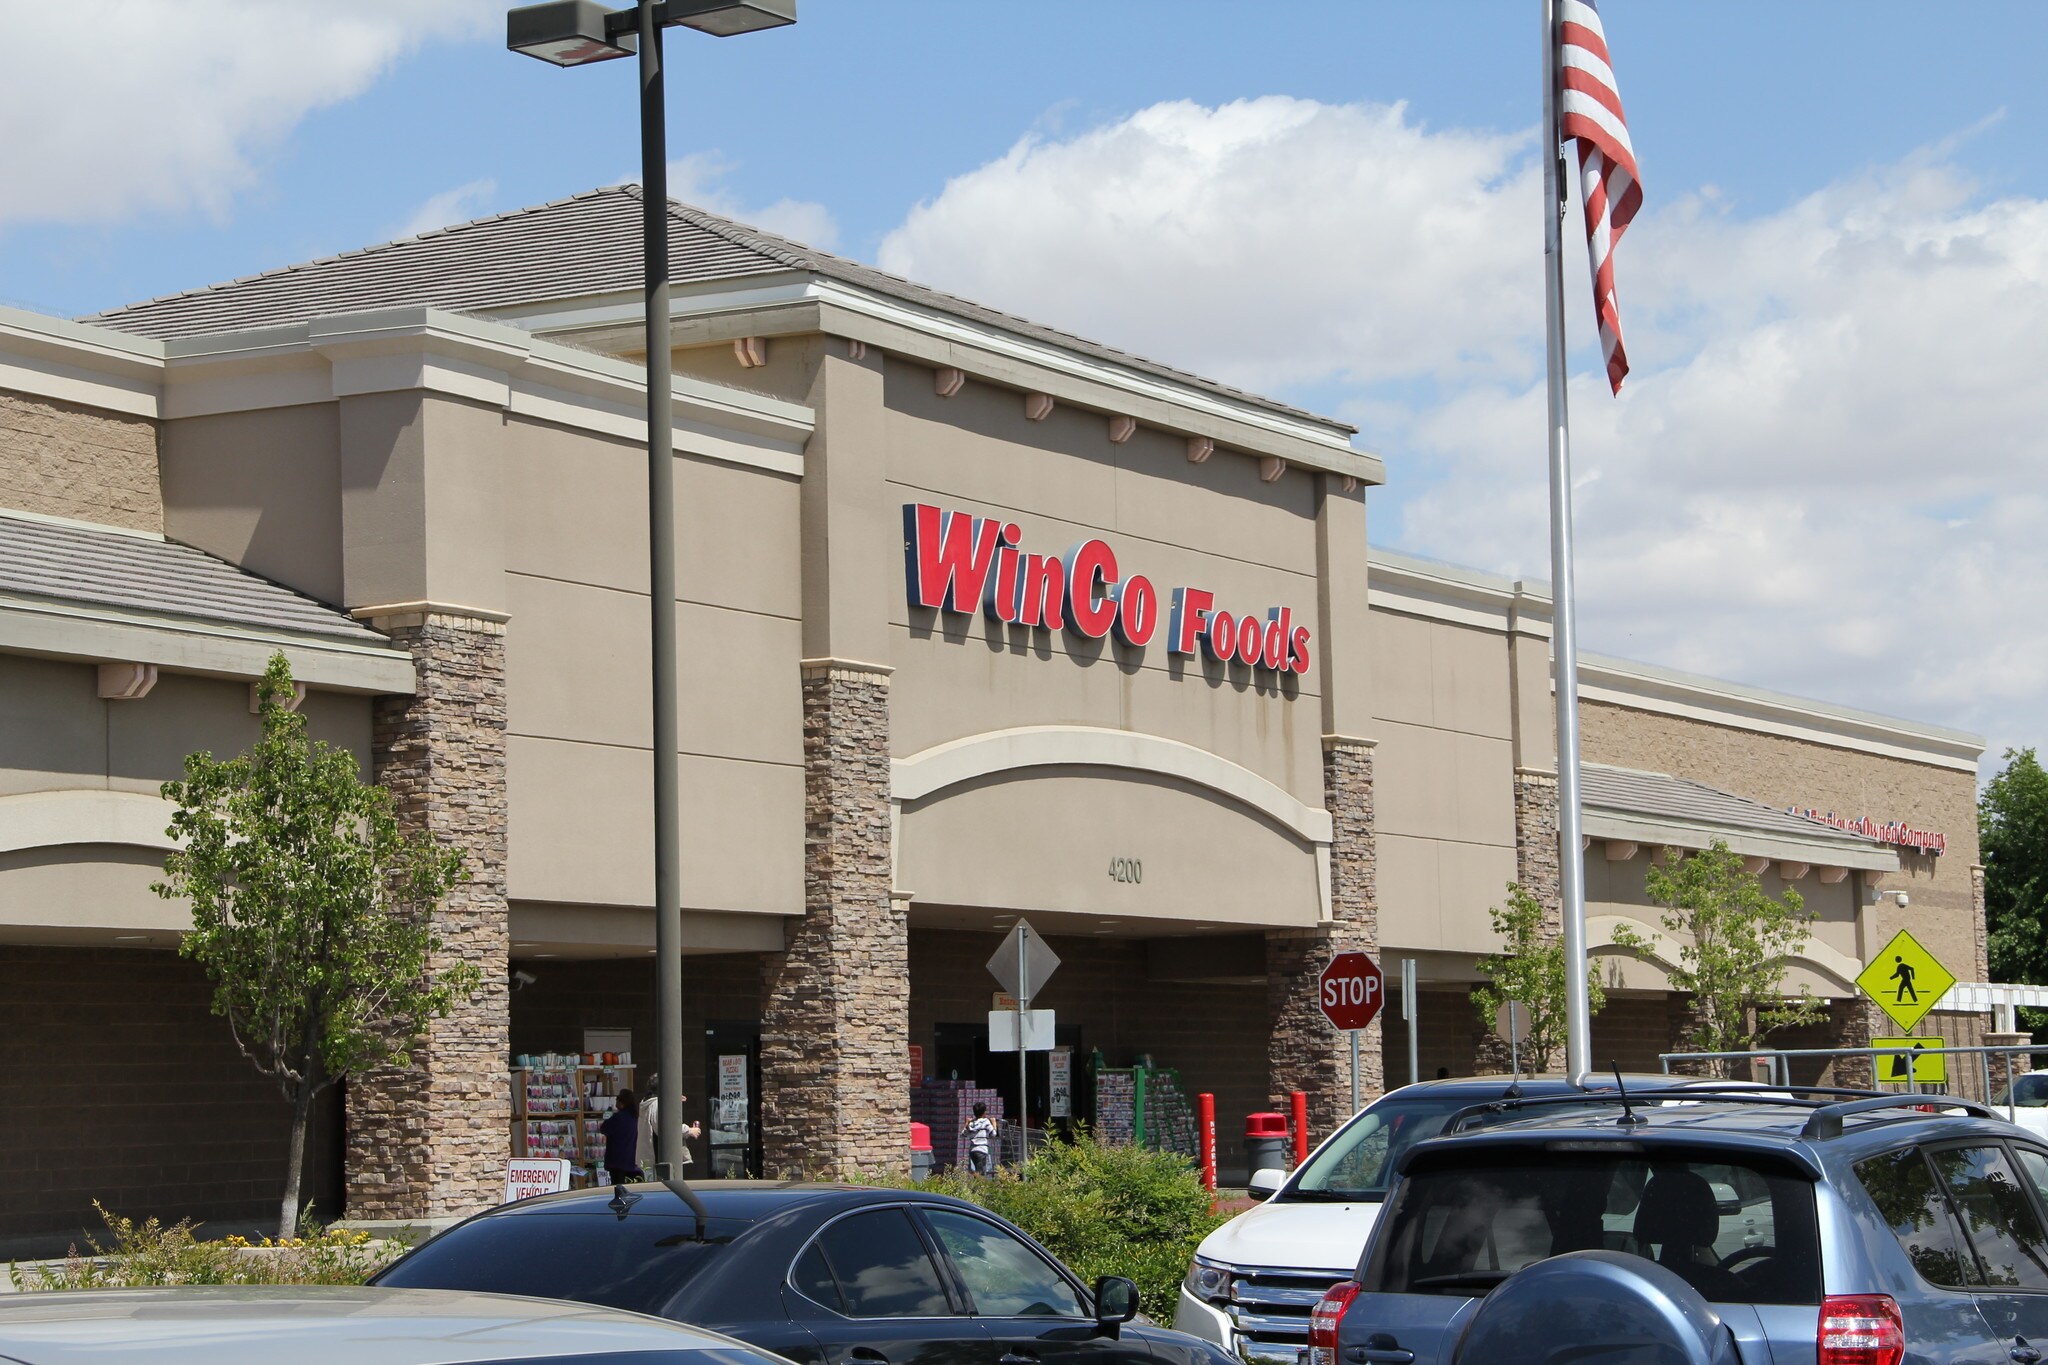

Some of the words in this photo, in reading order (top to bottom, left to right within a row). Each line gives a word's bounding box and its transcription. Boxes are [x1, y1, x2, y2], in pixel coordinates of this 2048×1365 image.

[903, 502, 1158, 647] WinCo
[1170, 587, 1311, 675] Foods
[1860, 816, 1898, 843] Owned
[1899, 821, 1947, 856] Company
[1108, 857, 1142, 884] 4200
[1324, 976, 1379, 1007] STOP
[1210, 1121, 1216, 1135] NO
[510, 1169, 558, 1184] EMERGENCY
